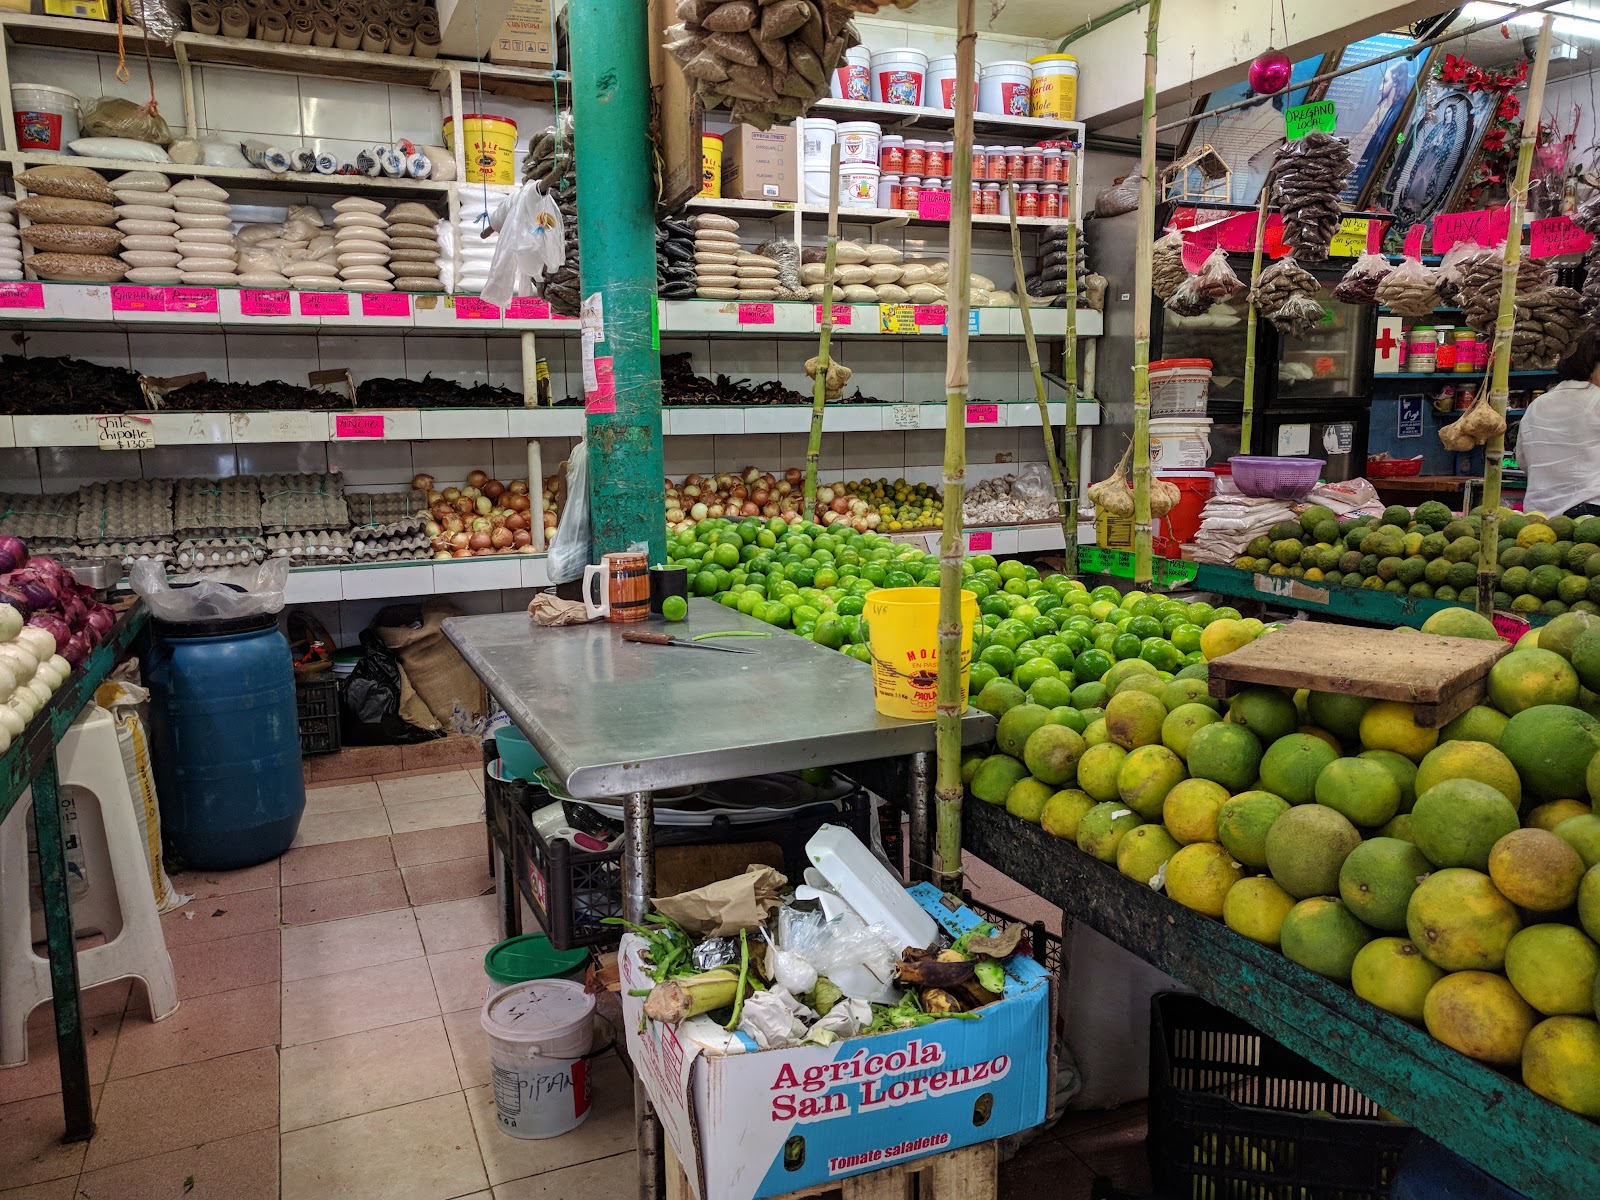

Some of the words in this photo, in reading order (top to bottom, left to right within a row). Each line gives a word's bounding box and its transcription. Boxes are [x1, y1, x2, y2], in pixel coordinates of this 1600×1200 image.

[1286, 103, 1334, 123] OREGANO
[1297, 118, 1324, 130] LOCAL
[1434, 215, 1487, 237] CLAVO
[98, 416, 131, 429] Chile
[340, 418, 378, 429] ANCHO
[906, 648, 936, 662] MOL
[770, 1041, 942, 1093] Agrícola
[771, 1092, 848, 1122] San
[860, 1054, 1009, 1106] Lorenzo
[830, 1149, 883, 1172] Tomate
[884, 1133, 949, 1159] saladette
